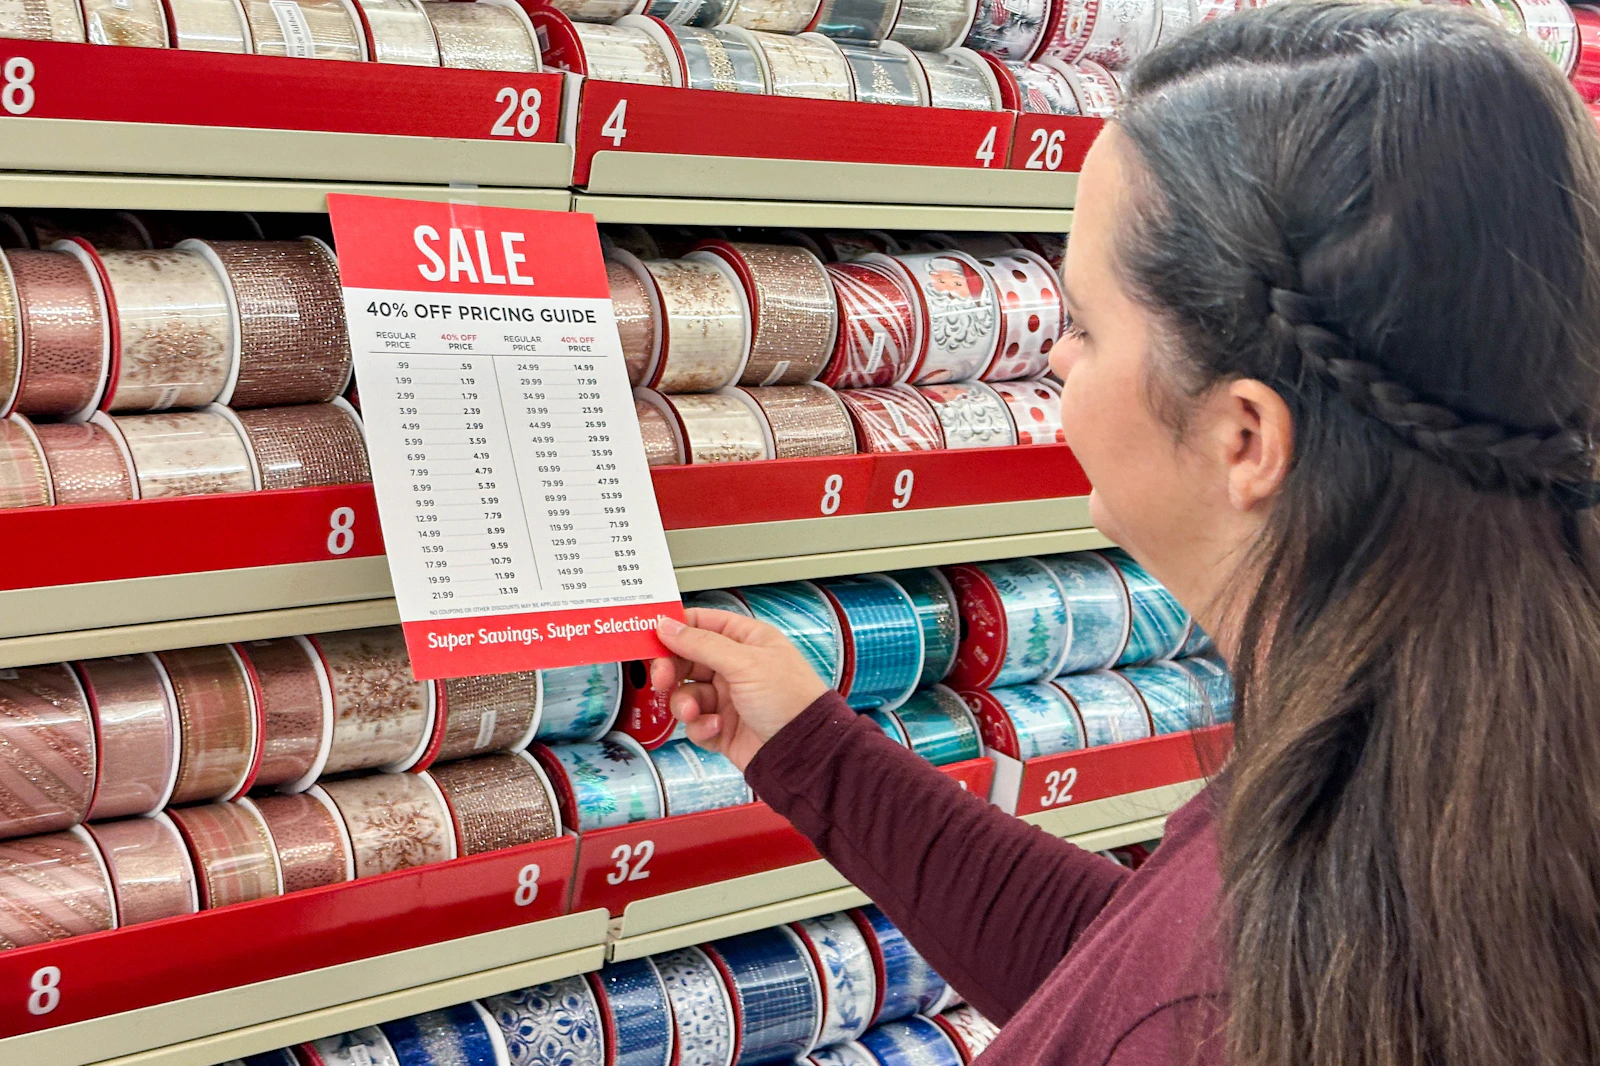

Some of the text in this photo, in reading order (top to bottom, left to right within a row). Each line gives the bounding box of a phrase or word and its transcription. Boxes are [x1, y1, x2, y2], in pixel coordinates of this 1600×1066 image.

[2, 57, 35, 114] 8
[490, 87, 541, 137] 28
[601, 98, 627, 146] 4
[975, 126, 996, 167] 4
[1025, 127, 1066, 170] 26
[413, 224, 535, 285] SALE
[366, 301, 597, 324] 40% OFF PRICING GUIDE
[376, 331, 417, 340] REGULAR
[440, 333, 478, 342] 40% OFF
[503, 335, 542, 343] REGULAR
[560, 336, 595, 344] 40% OFF
[385, 340, 411, 349] PRICE
[448, 342, 474, 351] PRICE
[512, 344, 537, 352] PRICE
[568, 345, 592, 353] PRICE
[396, 361, 473, 371] .99 .59
[517, 363, 595, 372] 24.99 14.99
[395, 376, 475, 385] 1.99 1.19
[520, 378, 598, 386] 29.99 17.99
[396, 392, 478, 400] 2.99 1.79
[523, 392, 601, 400] 34.99 20.99
[399, 407, 481, 415] 3.99 2.39
[526, 406, 604, 415] 39.99 23.99
[401, 422, 484, 431] 4.99 2.99
[528, 420, 607, 429] 44.99 26.99
[404, 437, 487, 446] 5.99 3.59
[532, 434, 610, 444] 49.99 29.99
[406, 452, 490, 461] 6.99 4.19
[535, 449, 613, 458] 59.99 35.99
[410, 467, 493, 477] 7.99 4.79
[538, 463, 616, 473] 69.99 41.99
[412, 481, 496, 492] 8.99 5.39
[541, 477, 620, 488] 79.99 47.99
[821, 474, 843, 515] 8
[893, 469, 914, 509] 9
[415, 496, 499, 508] 9.99 5.99
[544, 491, 623, 502] 89.99 53.99
[415, 511, 502, 523] 12.99 7.79
[547, 506, 626, 517] 99.99 59.99
[327, 506, 355, 555] 8
[549, 520, 630, 532] 119.99 71.99
[418, 526, 506, 538] 14.99 8.99
[551, 534, 633, 546] 129.99 77.99
[421, 541, 509, 554] 15.99 9.59
[554, 549, 636, 561] 139.99 83.99
[424, 556, 512, 569] 17.99 10.79
[557, 563, 640, 576] 149.99 89.99
[428, 571, 515, 584] 19.99 11.99
[561, 577, 643, 591] 159.99 95.99
[431, 586, 519, 600] 21.99 13.19
[427, 632, 475, 651] Super
[478, 626, 544, 645] Savings,
[547, 623, 591, 641] Super
[1039, 767, 1078, 807] 32
[607, 839, 656, 885] 32
[515, 864, 540, 906] 8
[28, 966, 61, 1015] 8
